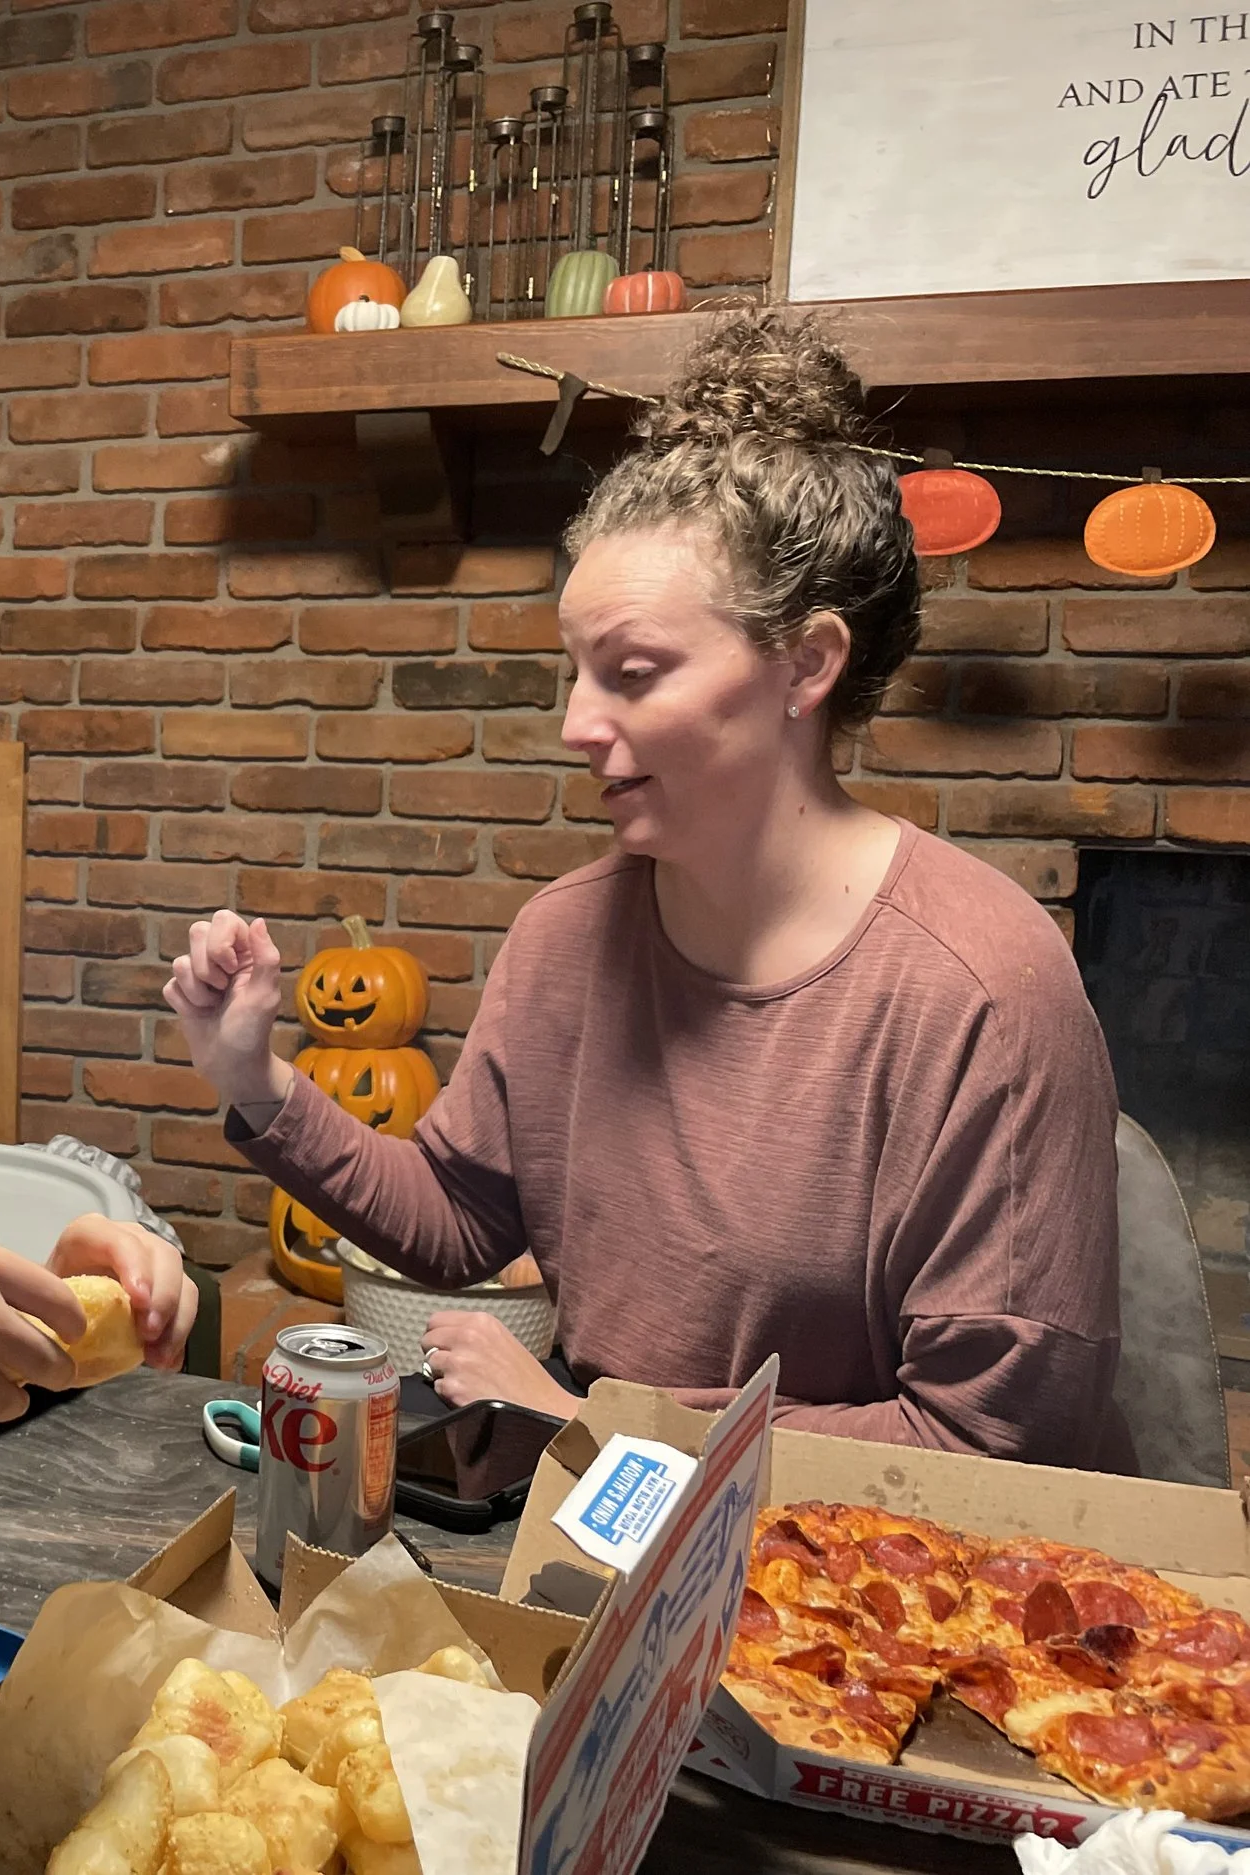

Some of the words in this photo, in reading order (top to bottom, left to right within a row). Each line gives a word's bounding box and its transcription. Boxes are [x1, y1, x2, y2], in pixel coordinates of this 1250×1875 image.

[1133, 20, 1176, 49] IN
[1057, 78, 1144, 108] AND
[1157, 71, 1232, 100] ATE
[1083, 93, 1250, 200] glad
[270, 1363, 323, 1403] Diet
[606, 1458, 645, 1502] MOUTH'S
[644, 1476, 660, 1493] MAY
[590, 1495, 619, 1525] MIND
[631, 1490, 651, 1511] BLOW
[618, 1510, 638, 1530] YOUR
[817, 1774, 910, 1809] FREE
[927, 1797, 1060, 1836] PIZZA?
